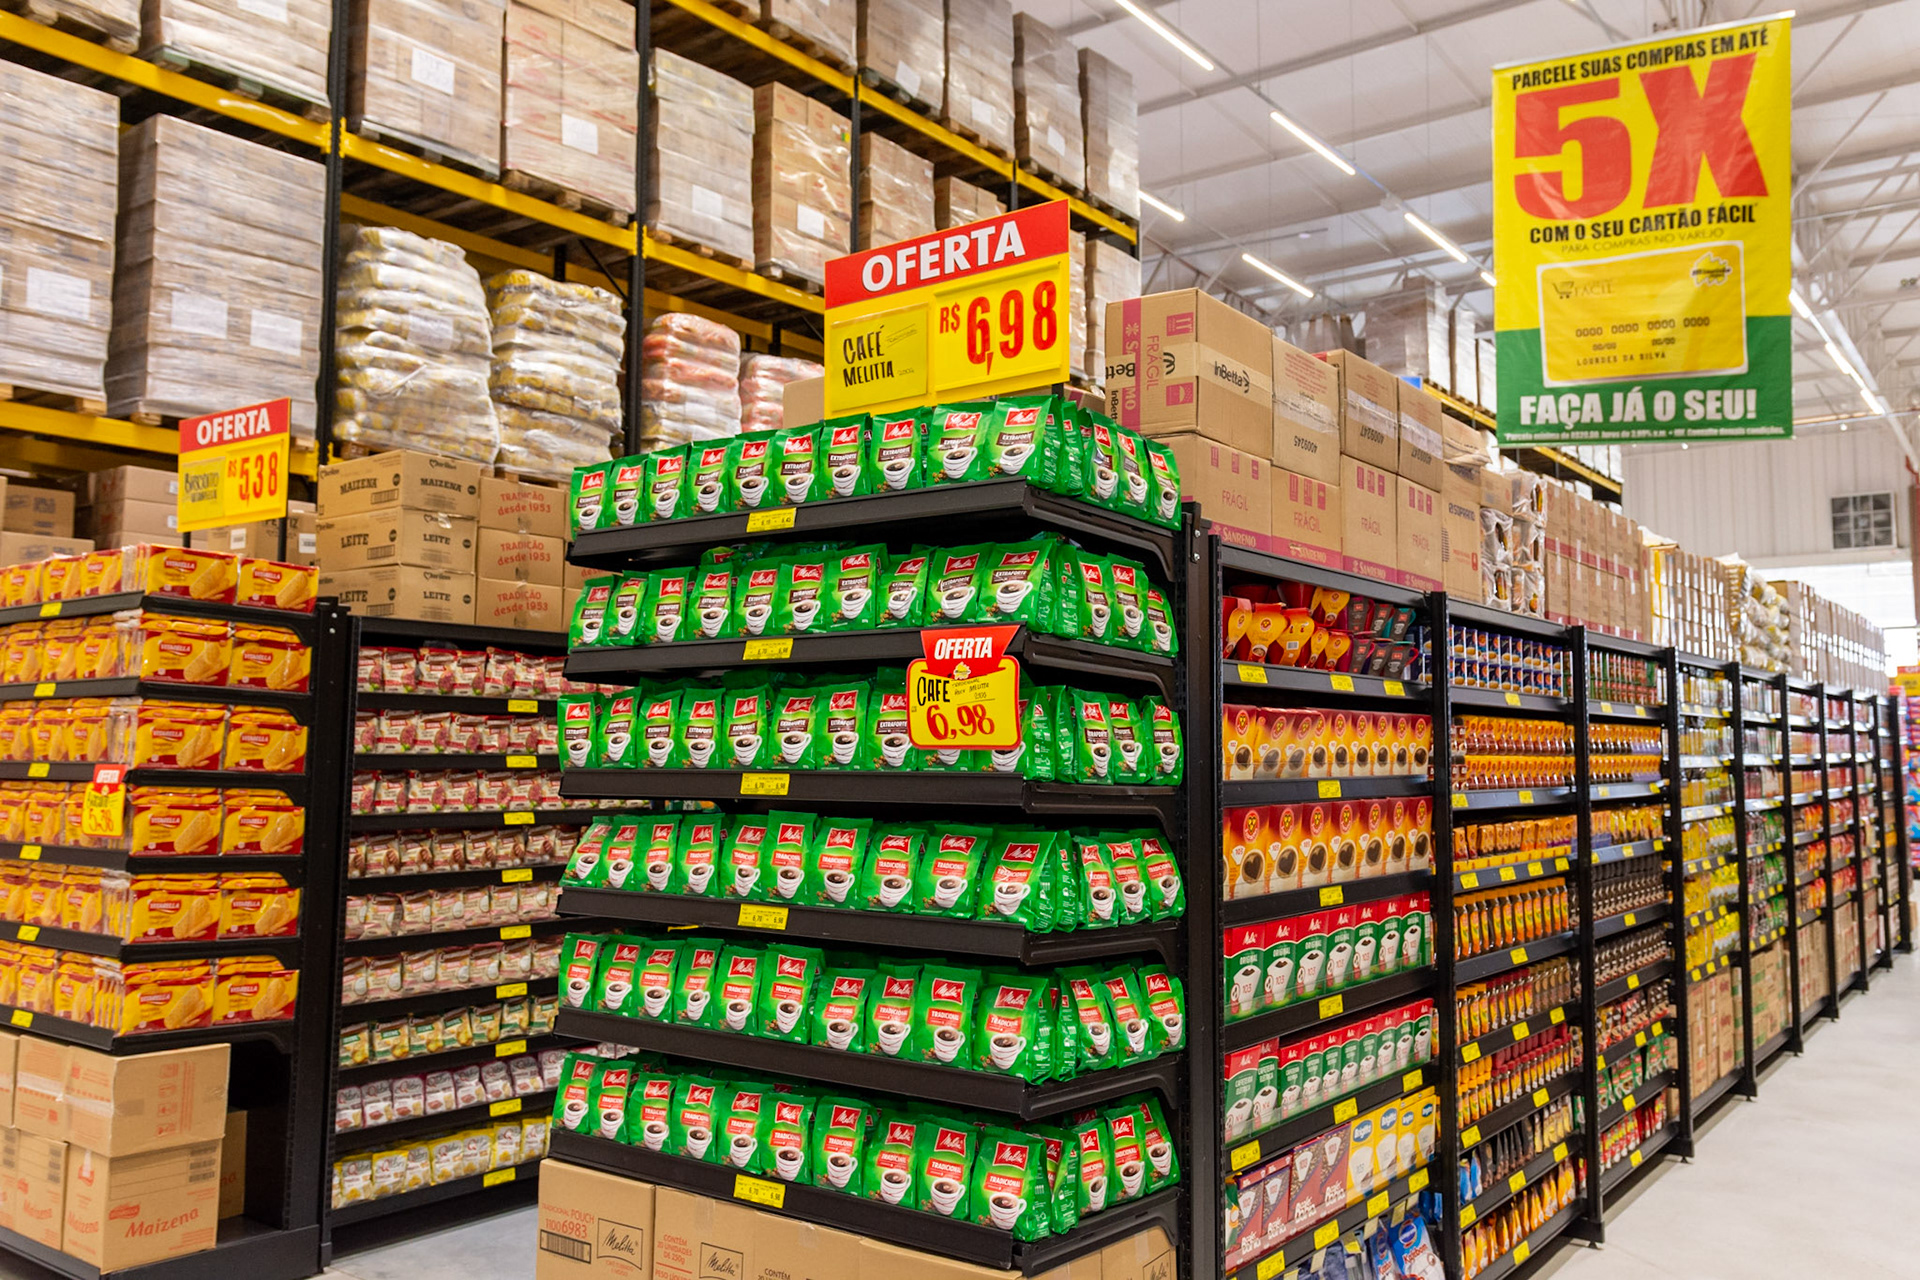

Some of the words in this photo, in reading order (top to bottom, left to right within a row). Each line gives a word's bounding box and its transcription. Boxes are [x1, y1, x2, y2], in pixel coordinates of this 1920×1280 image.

[1512, 63, 1576, 90] PARCELE
[1581, 56, 1622, 78] SUAS
[1626, 40, 1706, 70] COMPRAS
[1711, 35, 1735, 55] EM
[1739, 28, 1768, 49] ATÉ
[1514, 52, 1769, 220] 5X
[1530, 226, 1569, 243] COM
[1575, 224, 1586, 240] O
[1591, 220, 1623, 238] SEU
[1630, 209, 1701, 233] CARTÃO
[1561, 242, 1589, 253] PARA
[1597, 237, 1650, 251] COMPRAS
[1654, 233, 1675, 245] NO
[1678, 228, 1724, 241] VAREJO
[862, 220, 1026, 292] OFERTA
[940, 303, 960, 334] R$
[967, 280, 1057, 376] 6,98
[843, 324, 886, 364] CAFÉ
[1146, 335, 1160, 391] FRÁGIL
[1577, 355, 1618, 366] LOURDES
[1640, 352, 1666, 360] SILVA
[843, 360, 894, 388] MELITTA
[1214, 360, 1243, 387] InBetta
[1520, 392, 1603, 430] FAÇA
[1609, 387, 1646, 423] JÁ
[1653, 390, 1676, 422] O
[1684, 389, 1757, 421] SEU!
[196, 407, 271, 445] OFERTA
[1294, 435, 1318, 453] 4009245
[239, 451, 278, 507] 5,38
[340, 478, 377, 495] MAIZENA
[420, 478, 462, 493] MAIZENA
[497, 505, 527, 516] desde
[529, 504, 551, 513] 1953
[1222, 490, 1248, 512] FRÁGIL
[1294, 511, 1321, 533] FRÁGIL
[1361, 517, 1382, 536] FRÁGIL
[341, 534, 369, 548] LEITE
[423, 533, 451, 545] LEITE
[500, 541, 545, 551] TRADIÇÃO
[1222, 527, 1256, 548] SANREMO
[1412, 533, 1430, 551] FRÁGIL
[165, 560, 195, 569] VITARELLA
[497, 554, 527, 566] desde
[529, 552, 551, 562] 1953
[1360, 561, 1386, 580] SANREMO
[339, 591, 368, 603] LEITE
[423, 591, 451, 601] LEITE
[497, 589, 542, 602] TRADIÇÃO
[494, 602, 524, 617] desde
[526, 601, 548, 611] 1953
[934, 637, 992, 660] OFERTA
[927, 704, 995, 740] 6,98
[931, 1161, 962, 1174] TRADICIONAL
[990, 1176, 1021, 1187] TRADICIONAL
[124, 1207, 199, 1238] Maizena
[571, 1209, 594, 1224] POUCH
[604, 1228, 635, 1255] Melitta
[663, 1234, 688, 1245] CONTÉM
[706, 1252, 735, 1276] Melitta
[764, 1267, 791, 1278] CONTÉM
